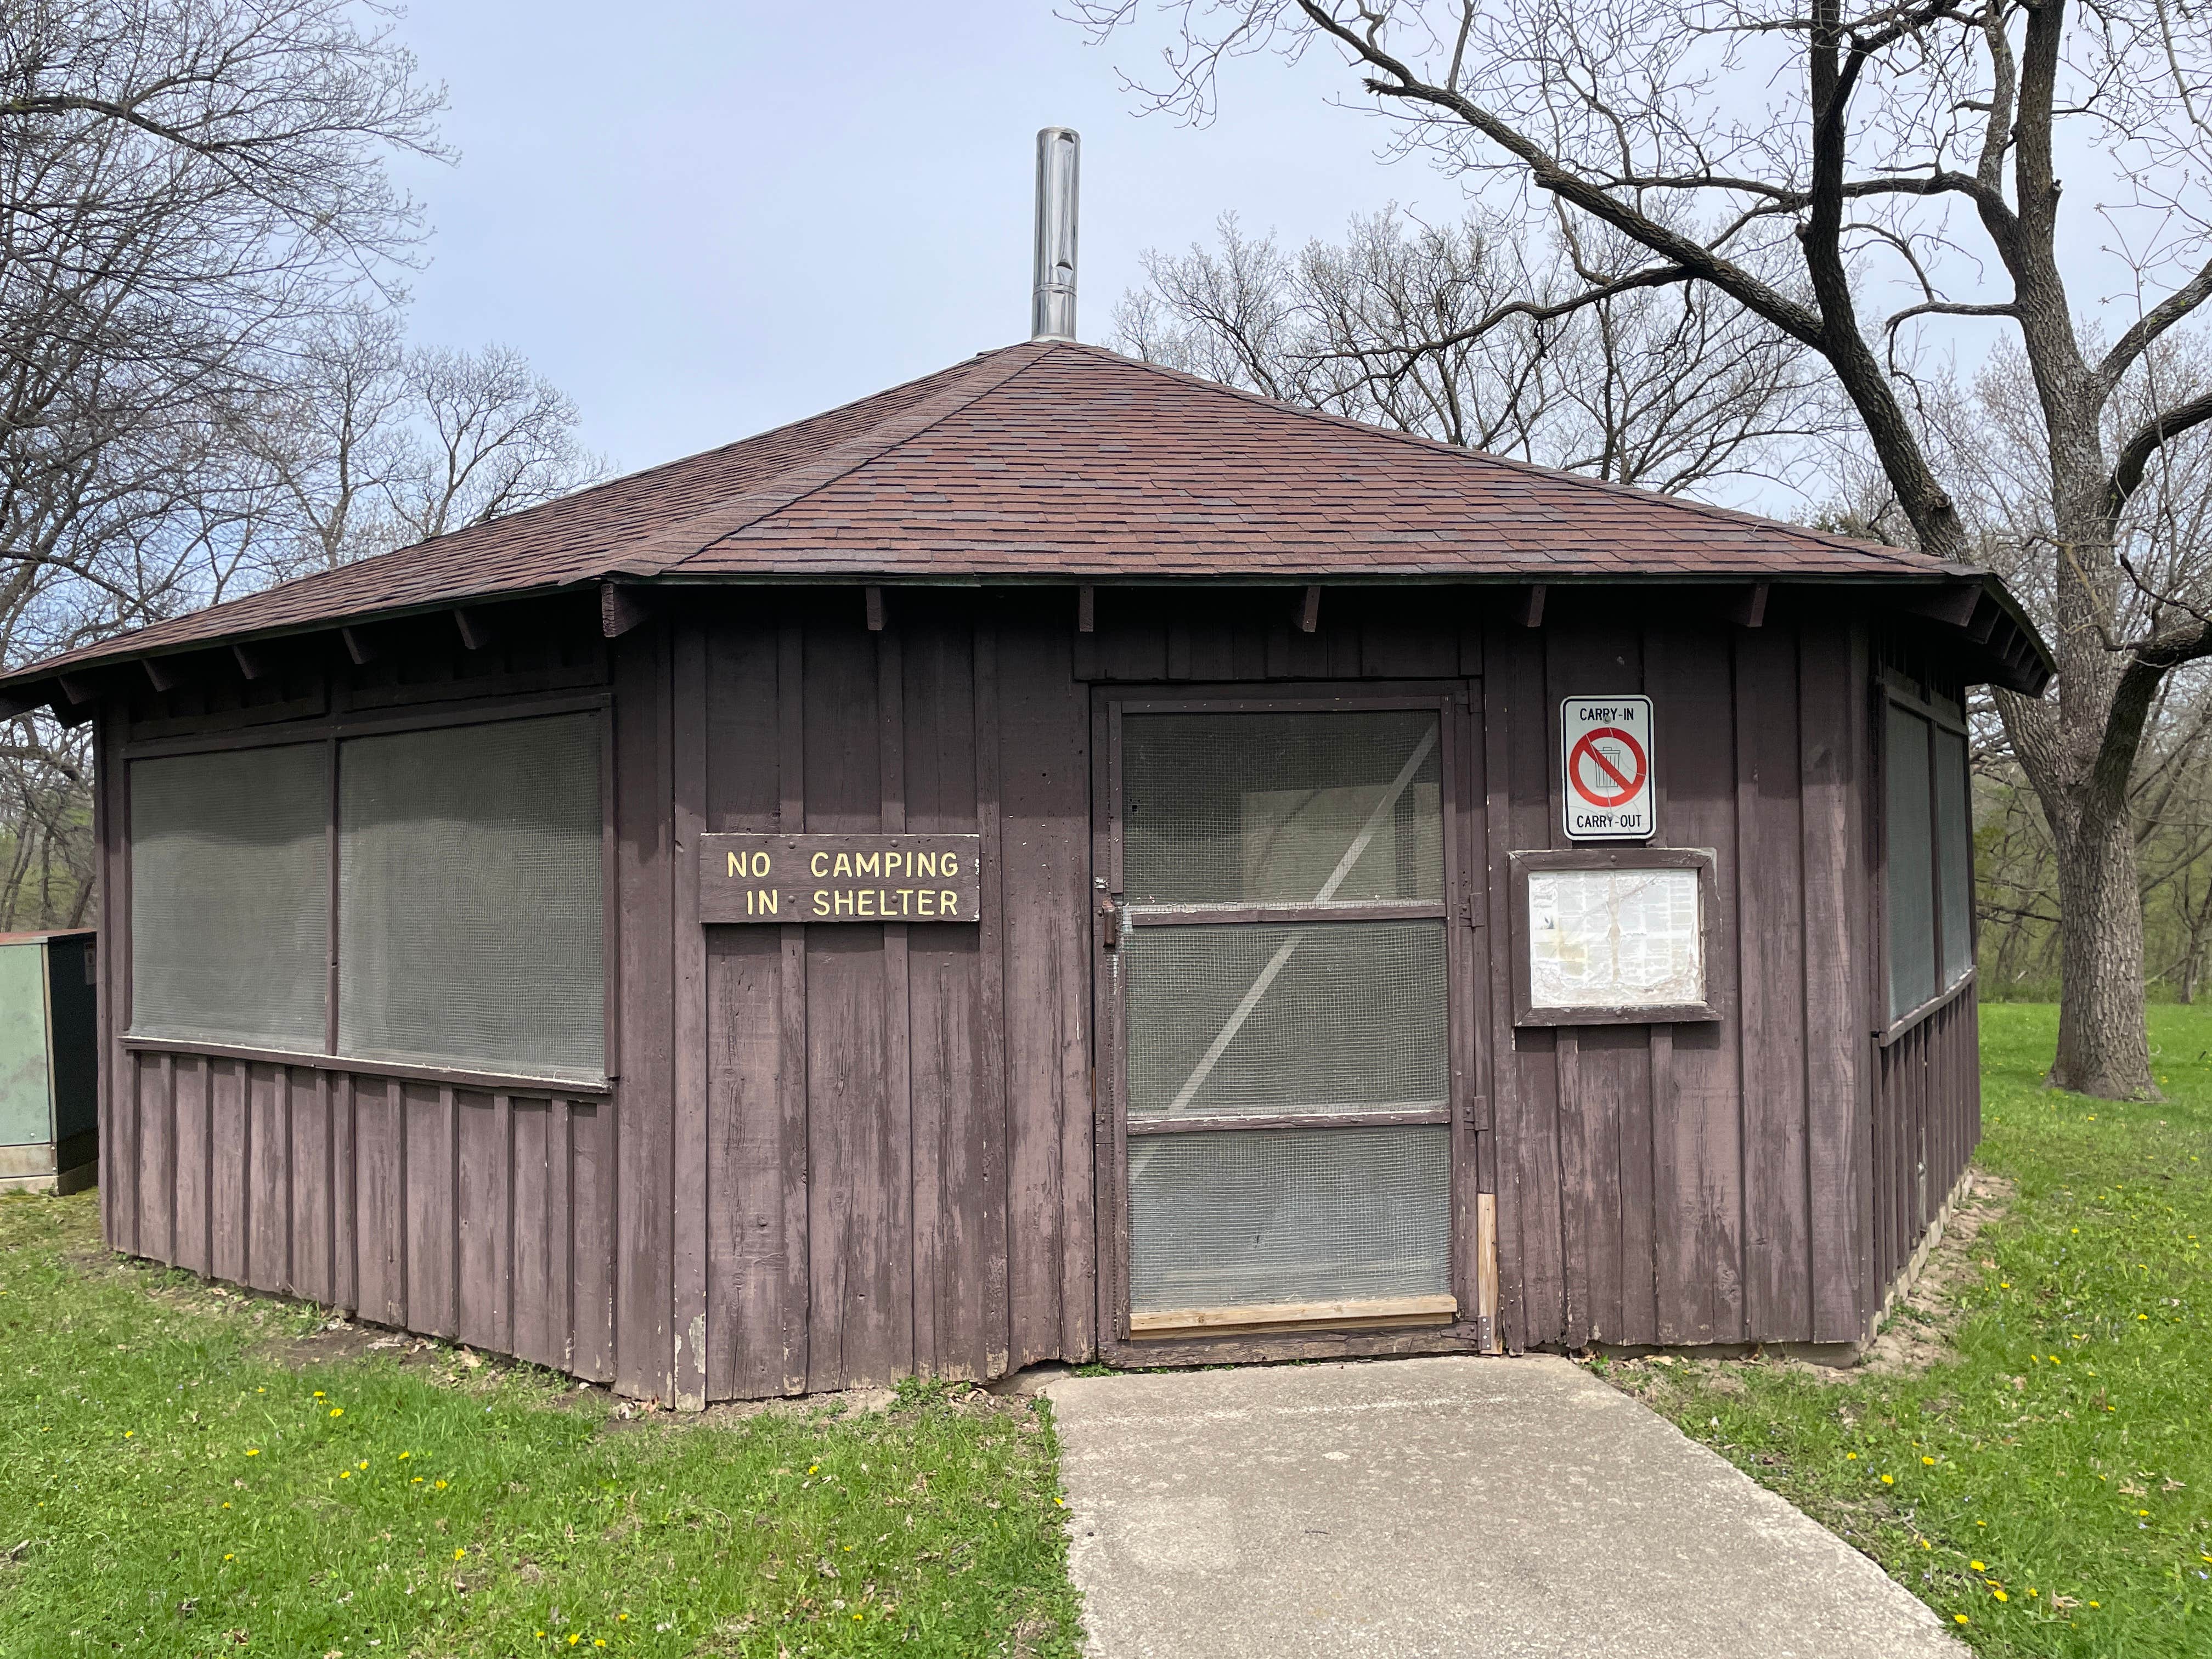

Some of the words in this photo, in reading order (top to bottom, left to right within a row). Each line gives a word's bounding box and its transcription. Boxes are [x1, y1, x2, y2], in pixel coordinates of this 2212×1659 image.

[1580, 708, 1634, 721] CARRY-IN
[727, 851, 771, 878] NO
[811, 851, 958, 878] CAMPING
[747, 889, 778, 916] IN
[813, 889, 958, 916] SHELTER
